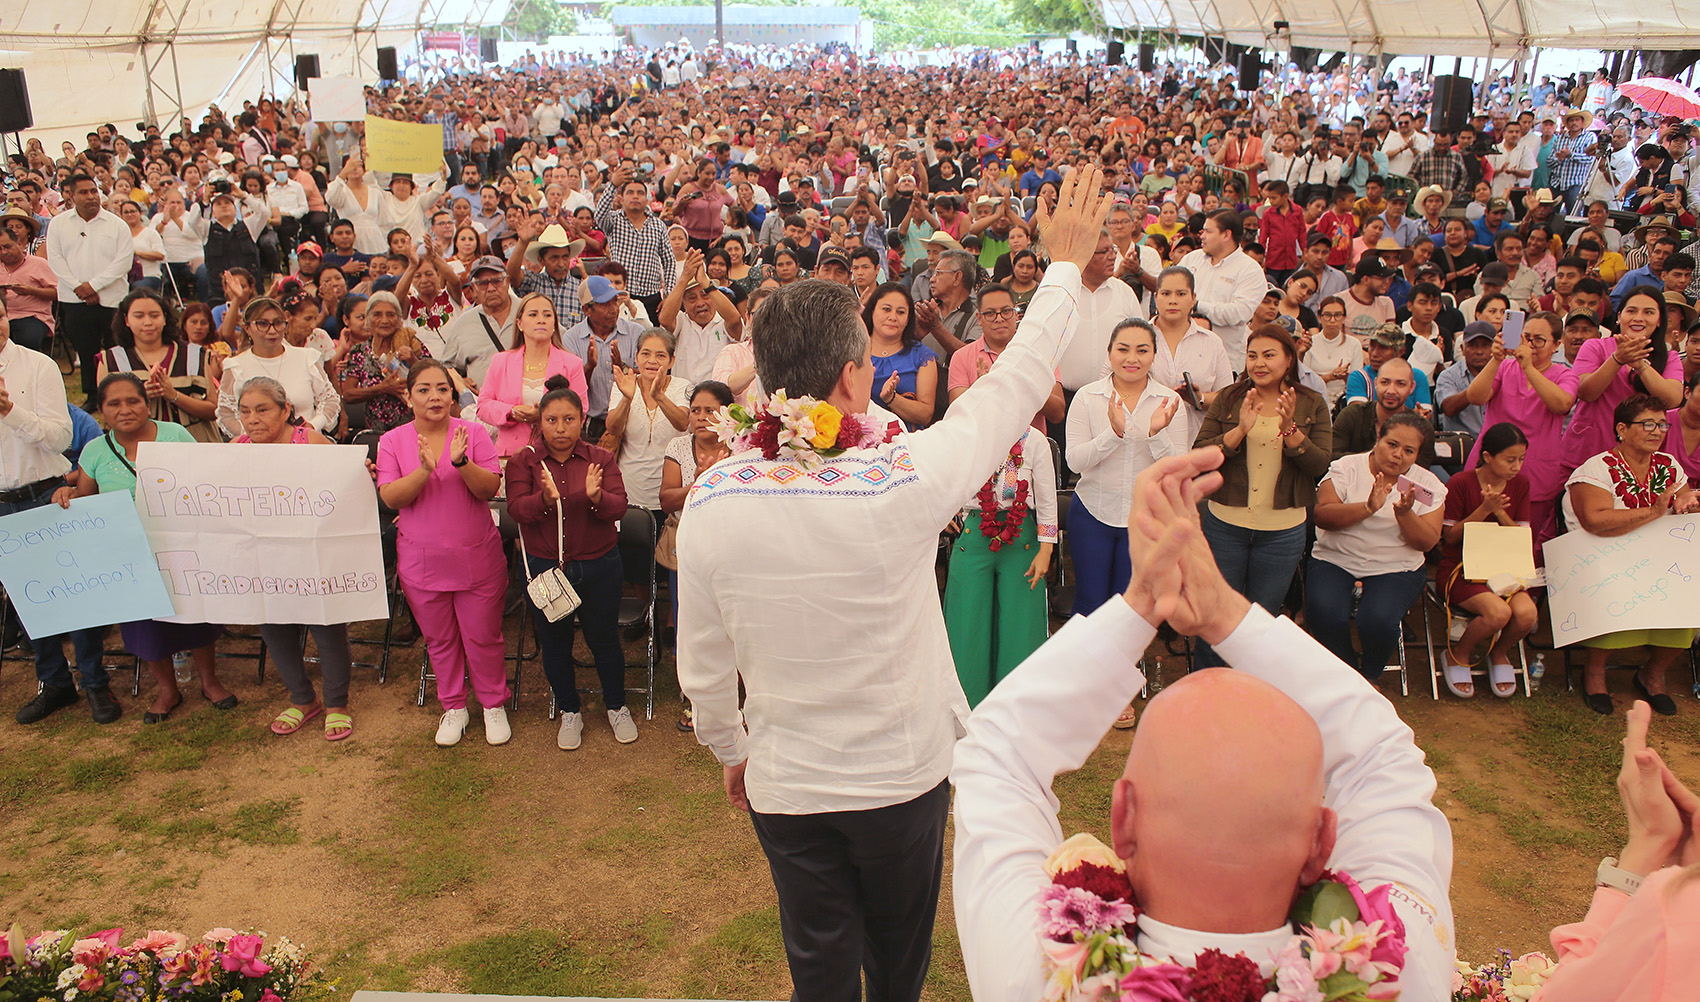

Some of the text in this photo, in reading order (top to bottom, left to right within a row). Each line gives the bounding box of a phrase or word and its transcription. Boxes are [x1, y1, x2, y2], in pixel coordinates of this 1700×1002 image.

[139, 467, 337, 518] PARTERAS
[55, 549, 80, 569] a
[155, 550, 379, 597] TRADICIONALES
